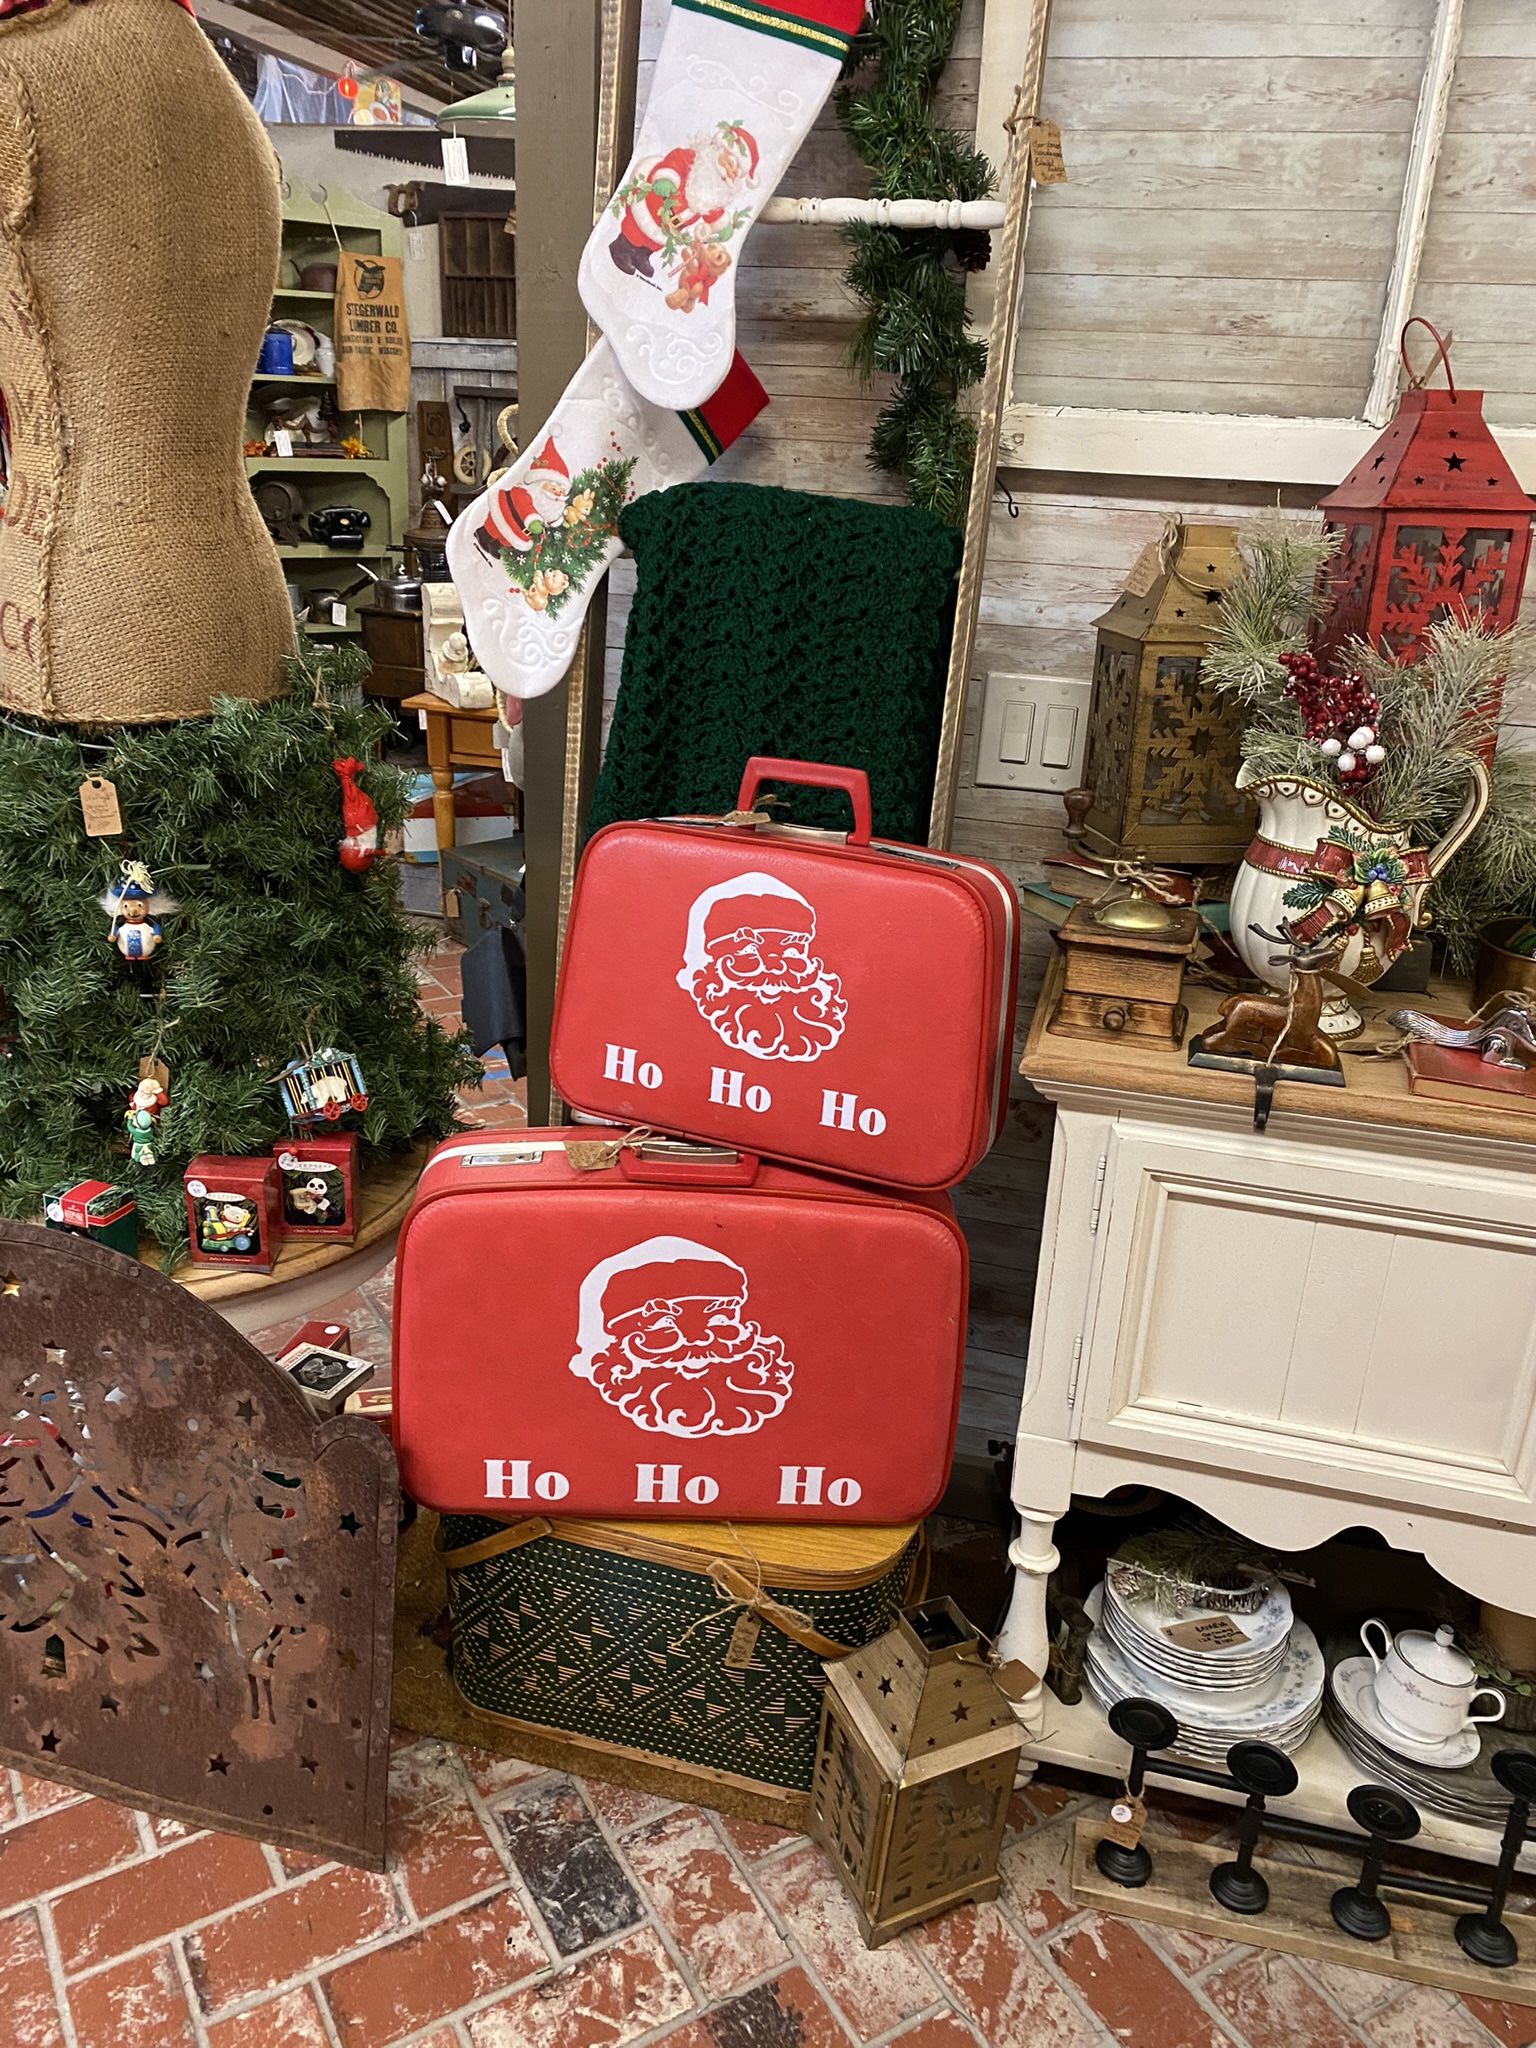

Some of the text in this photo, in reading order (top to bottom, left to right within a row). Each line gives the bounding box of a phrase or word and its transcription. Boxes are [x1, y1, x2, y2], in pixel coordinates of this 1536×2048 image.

[346, 303, 399, 318] STEGERWALD
[603, 1044, 886, 1135] Ho Ho Ho
[484, 1460, 861, 1506] Ho Ho Ho
